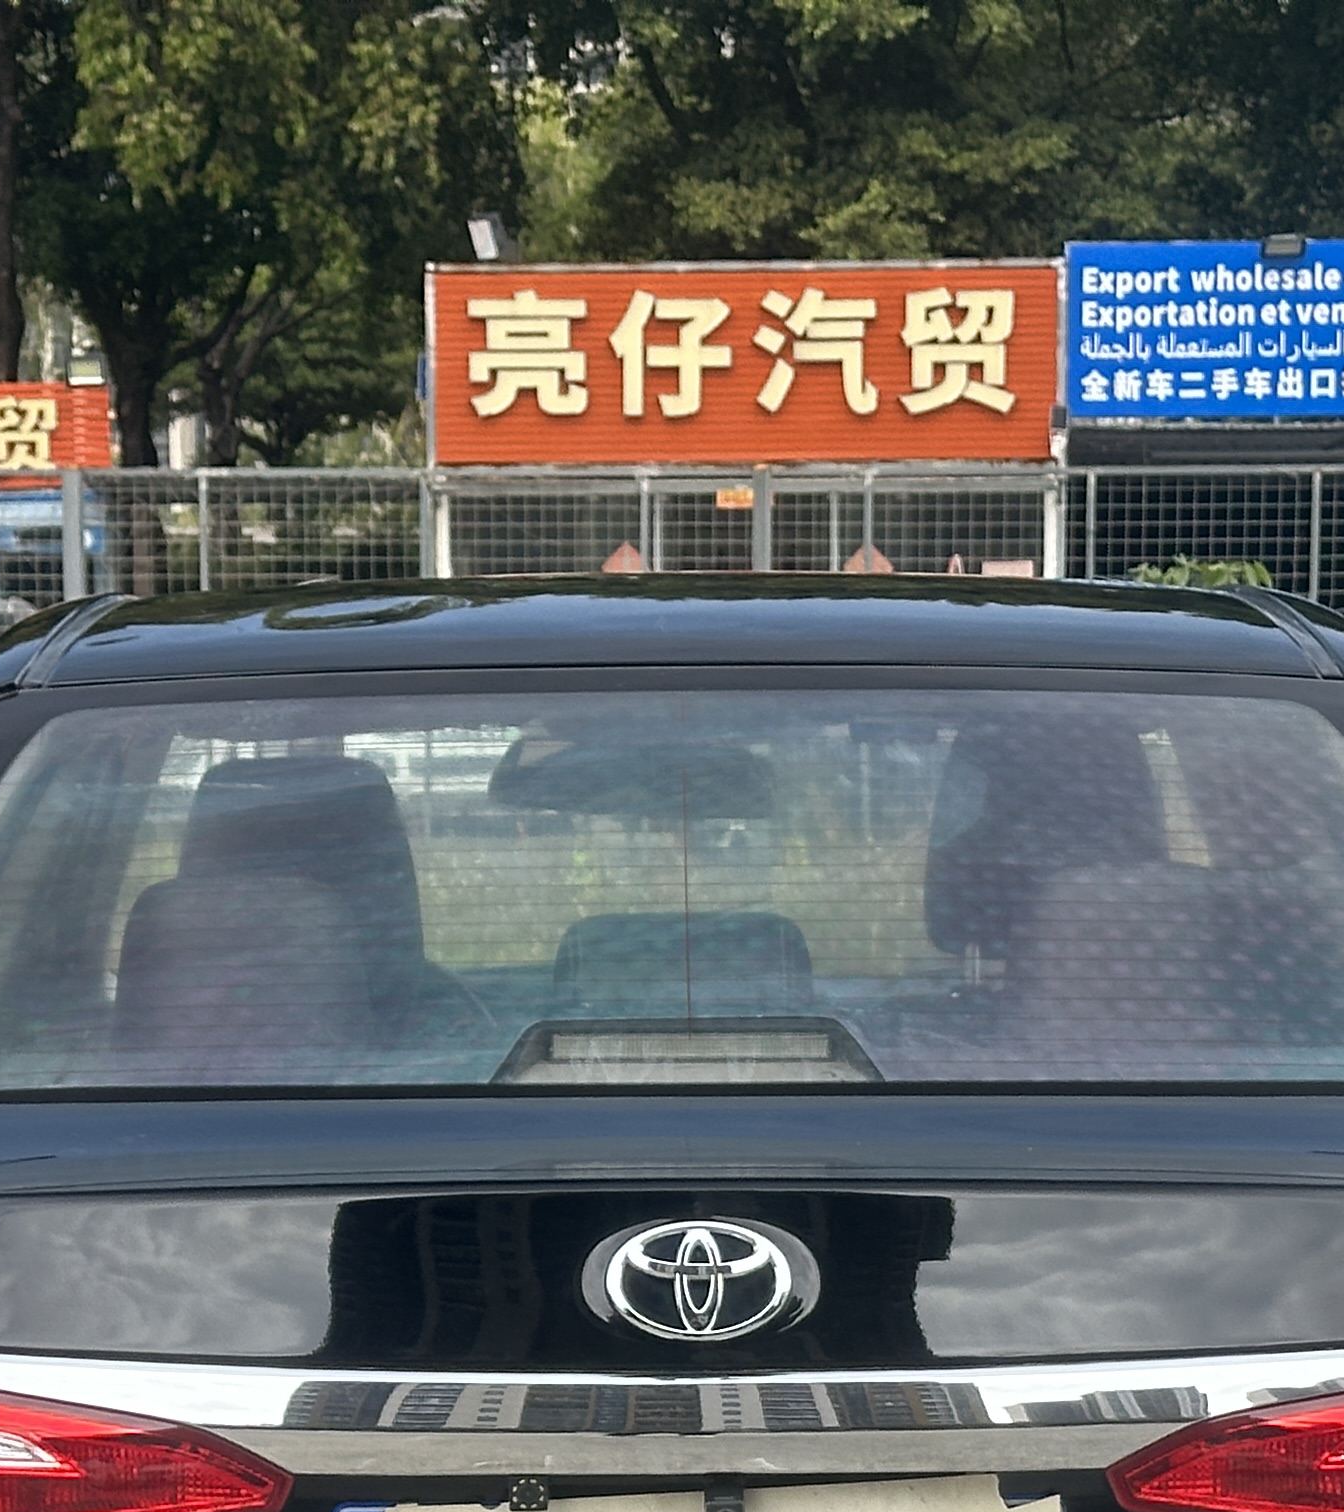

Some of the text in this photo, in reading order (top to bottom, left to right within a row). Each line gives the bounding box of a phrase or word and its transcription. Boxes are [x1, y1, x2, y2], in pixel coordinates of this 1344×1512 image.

[1081, 265, 1180, 299] Export
[1191, 261, 1342, 292] wholesale
[1080, 297, 1256, 333] Exportation
[1260, 299, 1292, 325] et
[466, 285, 1018, 420] 亮仔汽贸
[1079, 331, 1152, 364] بالجملة
[1155, 330, 1253, 360] المستعملة
